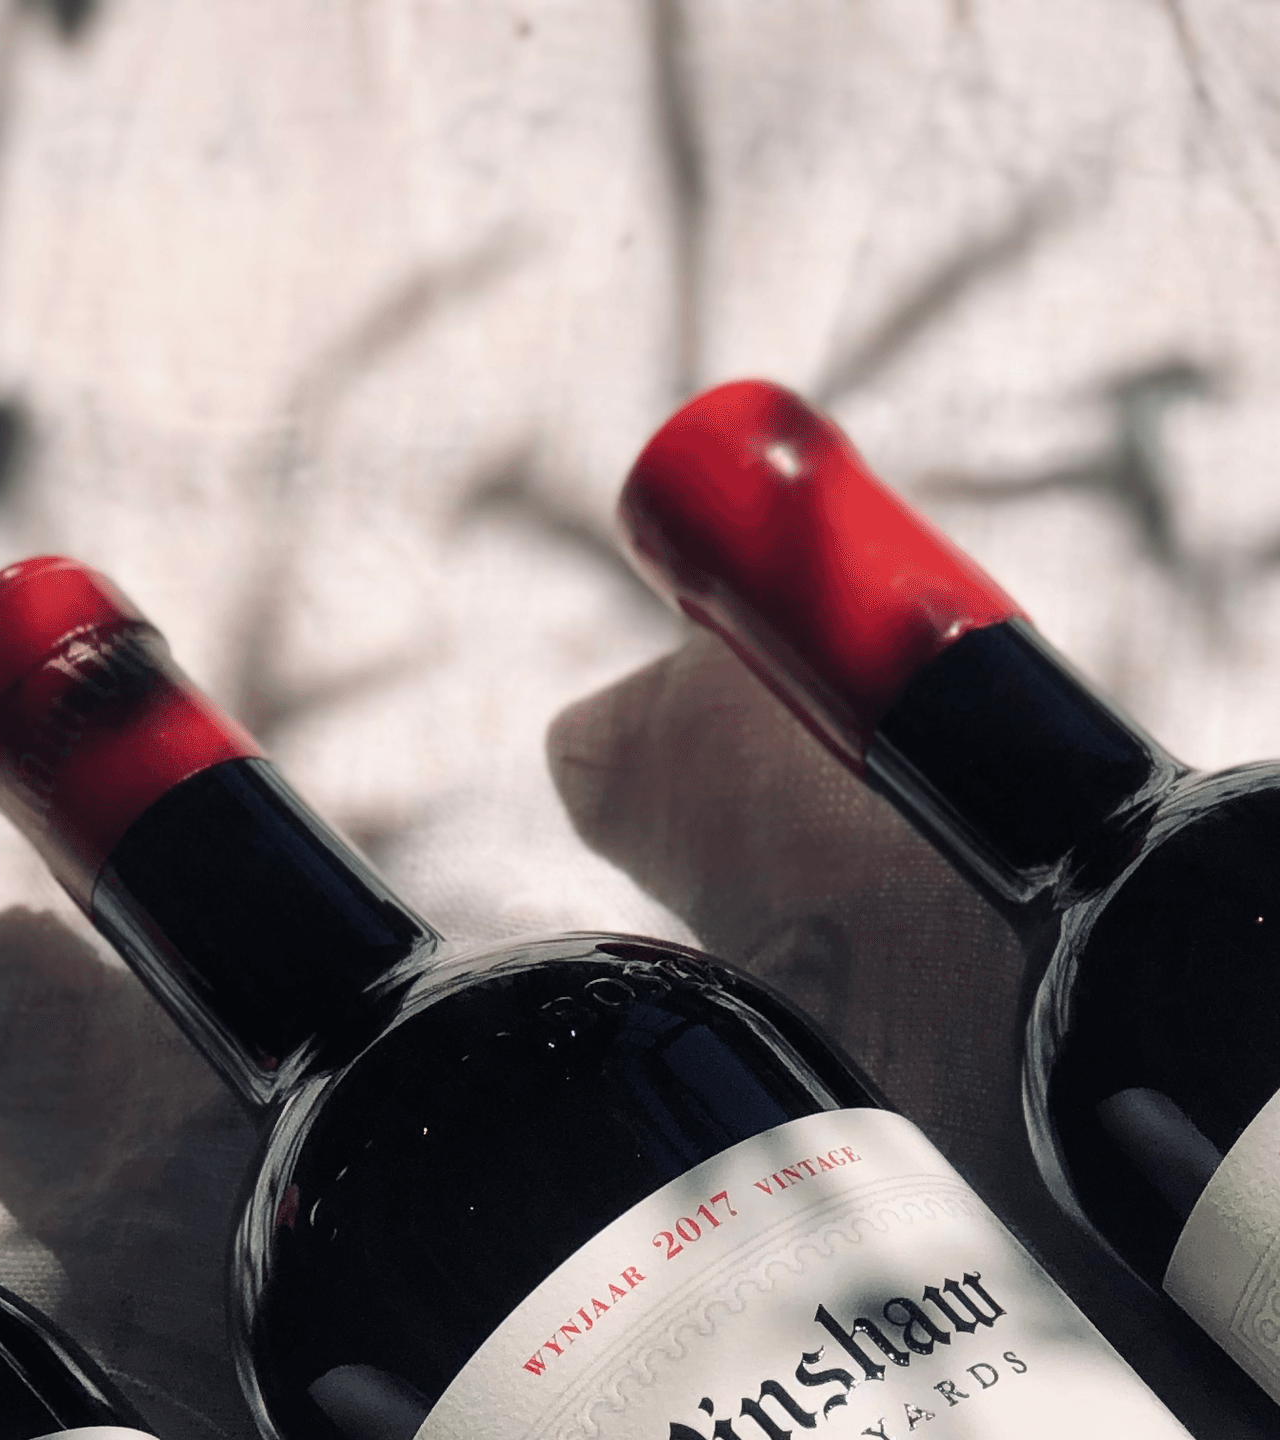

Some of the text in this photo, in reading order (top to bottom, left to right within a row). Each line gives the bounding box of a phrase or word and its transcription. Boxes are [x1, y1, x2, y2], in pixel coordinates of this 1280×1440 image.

[521, 1145, 862, 1378] WYNJAAR 2017 VINTAGE
